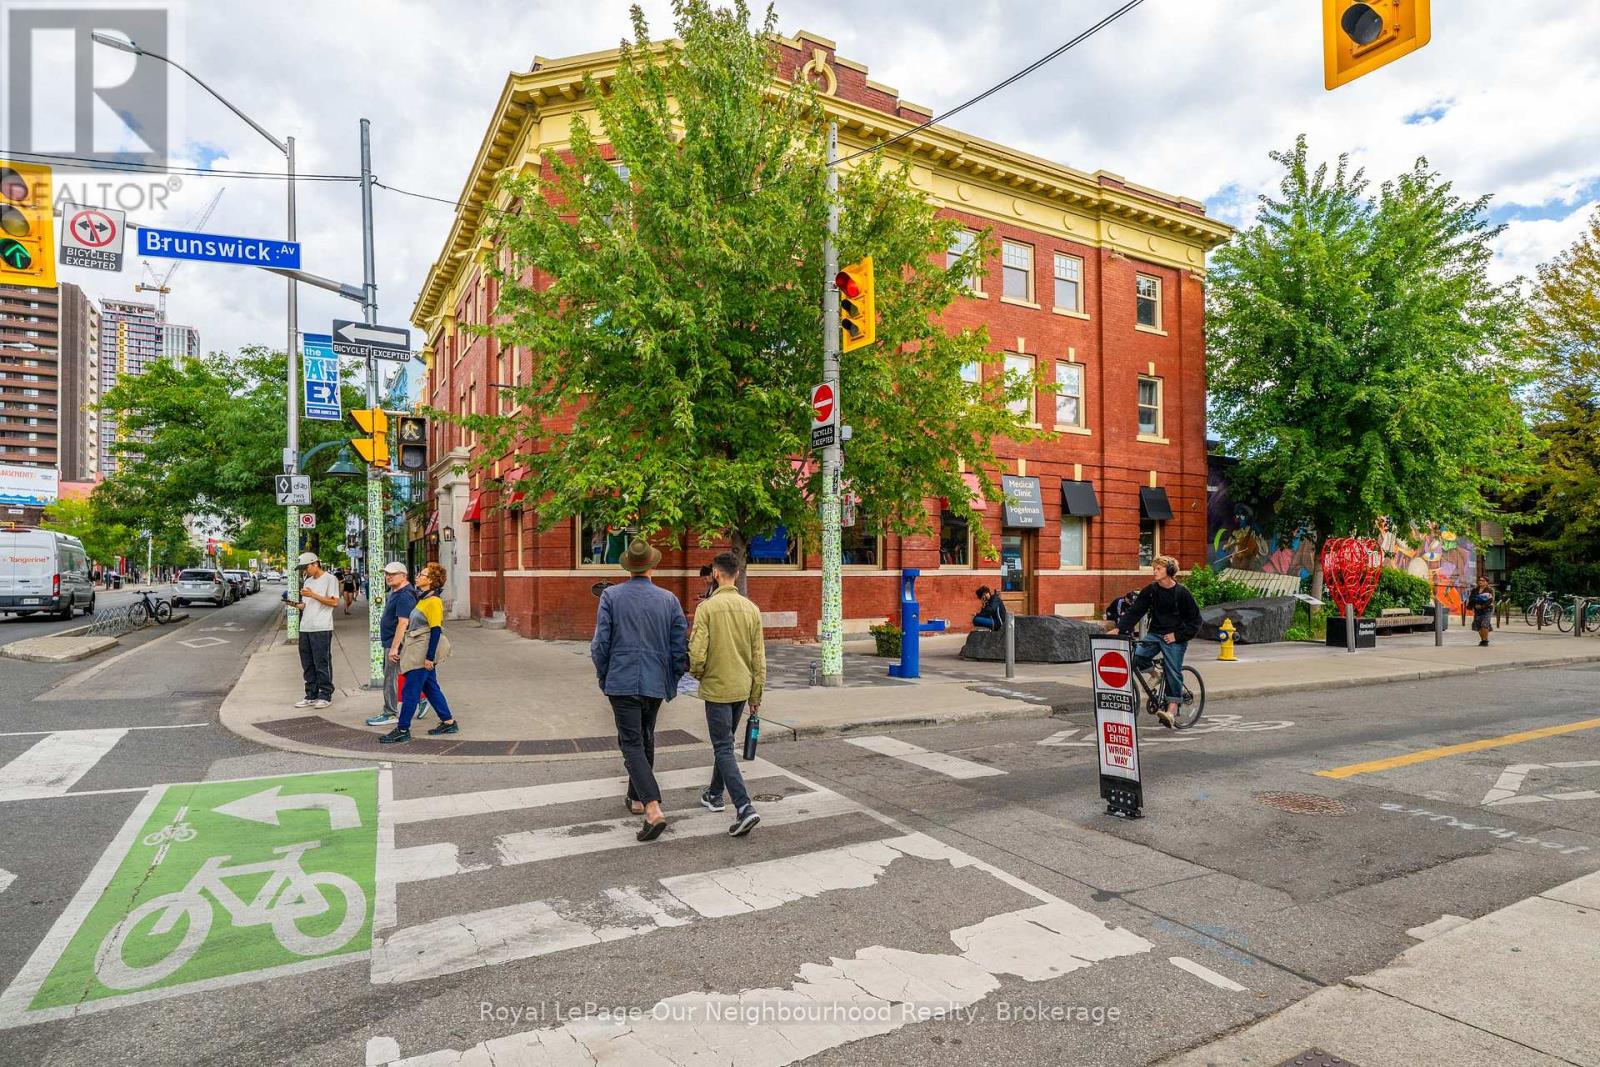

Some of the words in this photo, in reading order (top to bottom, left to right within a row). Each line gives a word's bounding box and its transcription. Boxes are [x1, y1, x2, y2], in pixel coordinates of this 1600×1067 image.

[147, 231, 271, 261] Brunswick
[281, 245, 295, 255] Av
[67, 247, 116, 262] BICYCLES
[66, 257, 116, 271] EXCEPTED
[305, 348, 321, 356] the
[373, 349, 410, 361] EXCEPTED
[1008, 479, 1034, 489] Medical
[1013, 489, 1032, 497] Clinic
[1102, 693, 1130, 703] BICYCLES
[1101, 702, 1132, 711] EXCEPTED
[1107, 724, 1117, 733] DO
[1118, 725, 1130, 736] NOT
[1109, 734, 1130, 745] ENTER
[1107, 746, 1132, 758] WRONG
[1114, 755, 1128, 766] WAY
